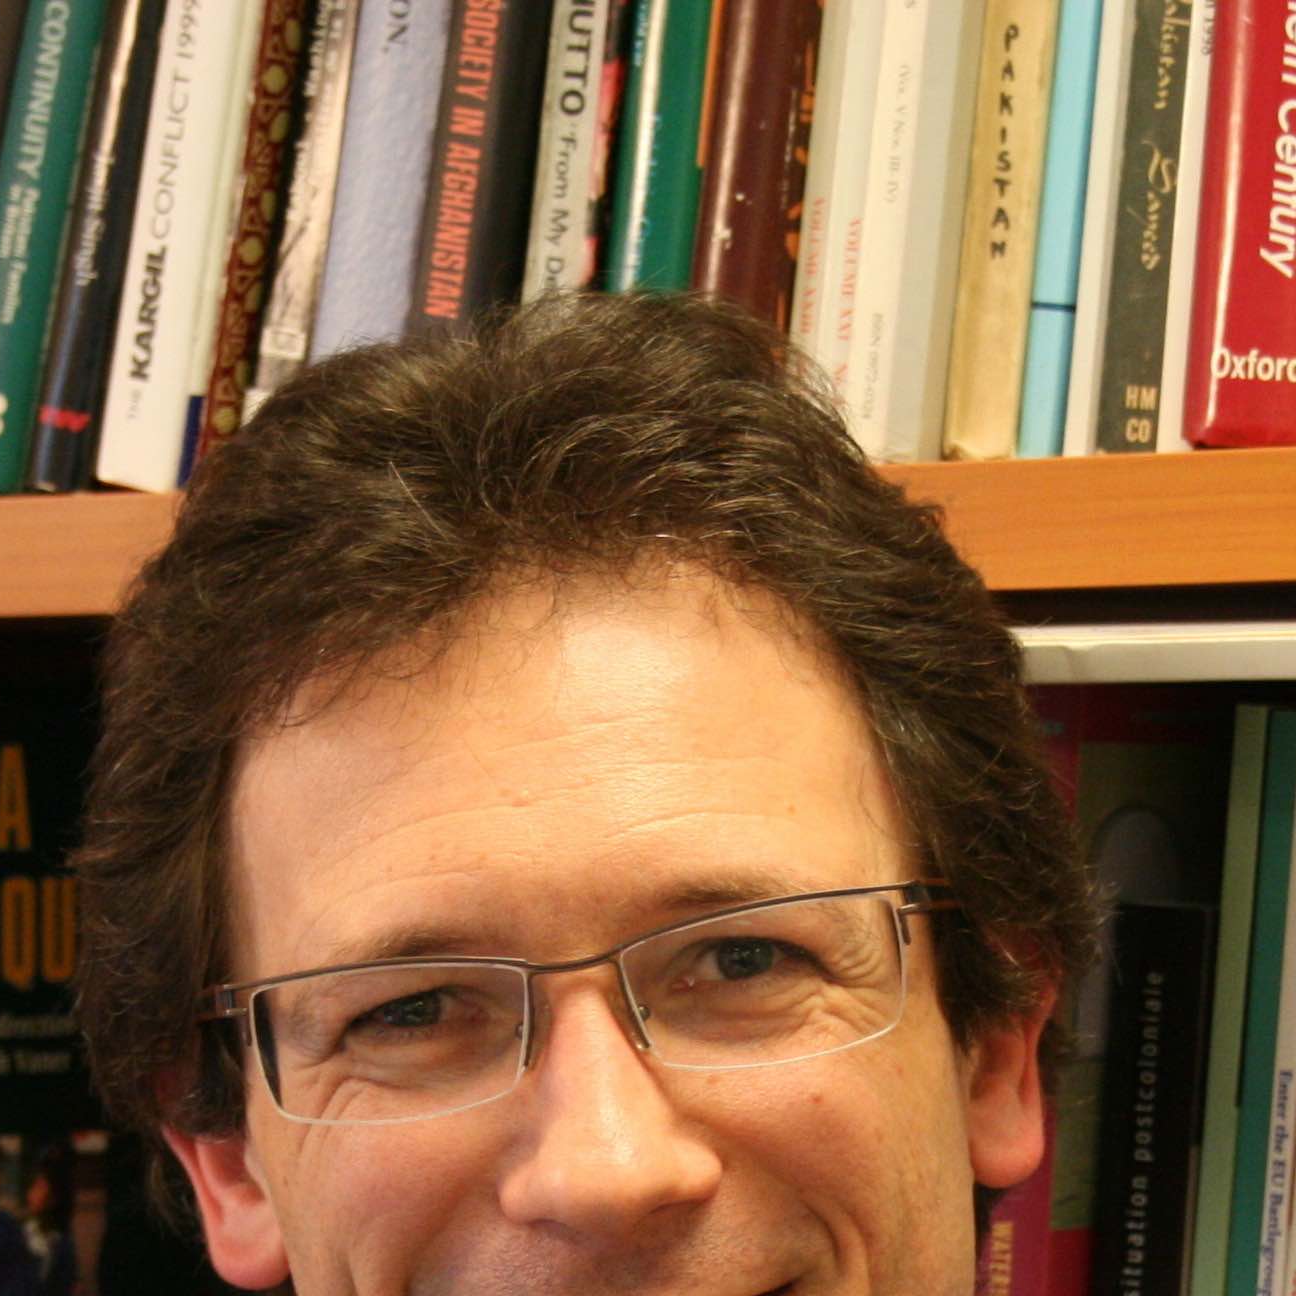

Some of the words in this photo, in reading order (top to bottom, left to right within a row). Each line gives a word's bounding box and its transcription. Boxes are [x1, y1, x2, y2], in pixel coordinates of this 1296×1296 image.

[455, 0, 504, 98] SOCIETY
[15, 0, 72, 181] CONTINUITY
[448, 105, 487, 137] IN
[990, 23, 1020, 261] PAKISTAN
[128, 246, 169, 383] KARGIL
[150, 66, 194, 241] CONFLICT
[423, 141, 483, 320] AFGHANISTAN
[543, 208, 571, 245] My
[1124, 384, 1158, 411] HM
[1125, 418, 1152, 444] CO
[1133, 970, 1165, 1163] postcoloniale
[1273, 1069, 1294, 1121] Enter
[1266, 1159, 1287, 1187] EU
